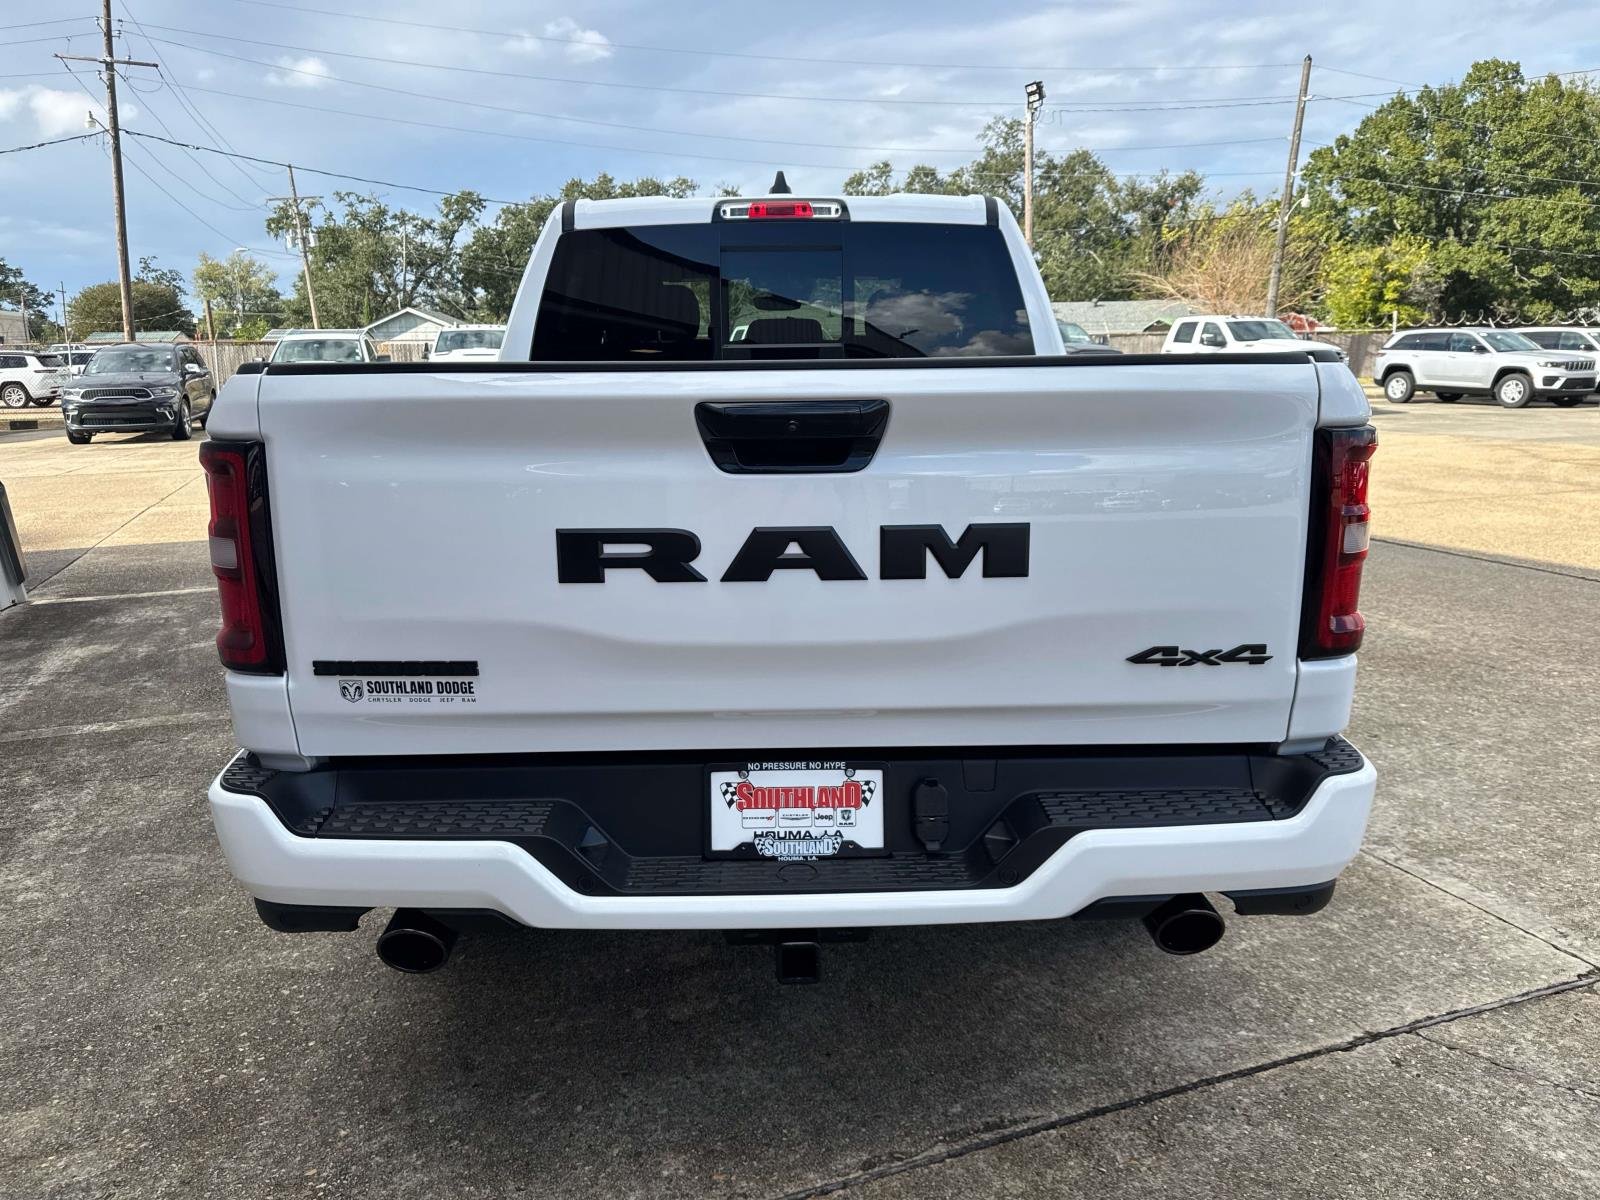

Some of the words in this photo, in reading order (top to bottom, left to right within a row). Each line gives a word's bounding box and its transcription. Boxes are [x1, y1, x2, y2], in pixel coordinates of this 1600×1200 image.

[556, 522, 1031, 584] RAM
[1125, 643, 1274, 667] 4x4
[366, 680, 433, 694] SOUTHLAND
[436, 681, 475, 694] DODGE
[747, 762, 761, 771] NO
[762, 762, 807, 770] PRESSURE
[809, 762, 822, 770] NO
[823, 761, 846, 769] HYPE
[736, 781, 862, 811] SOUTHLAND
[815, 813, 834, 821] Jeep
[764, 838, 833, 855] SOUTHLAND
